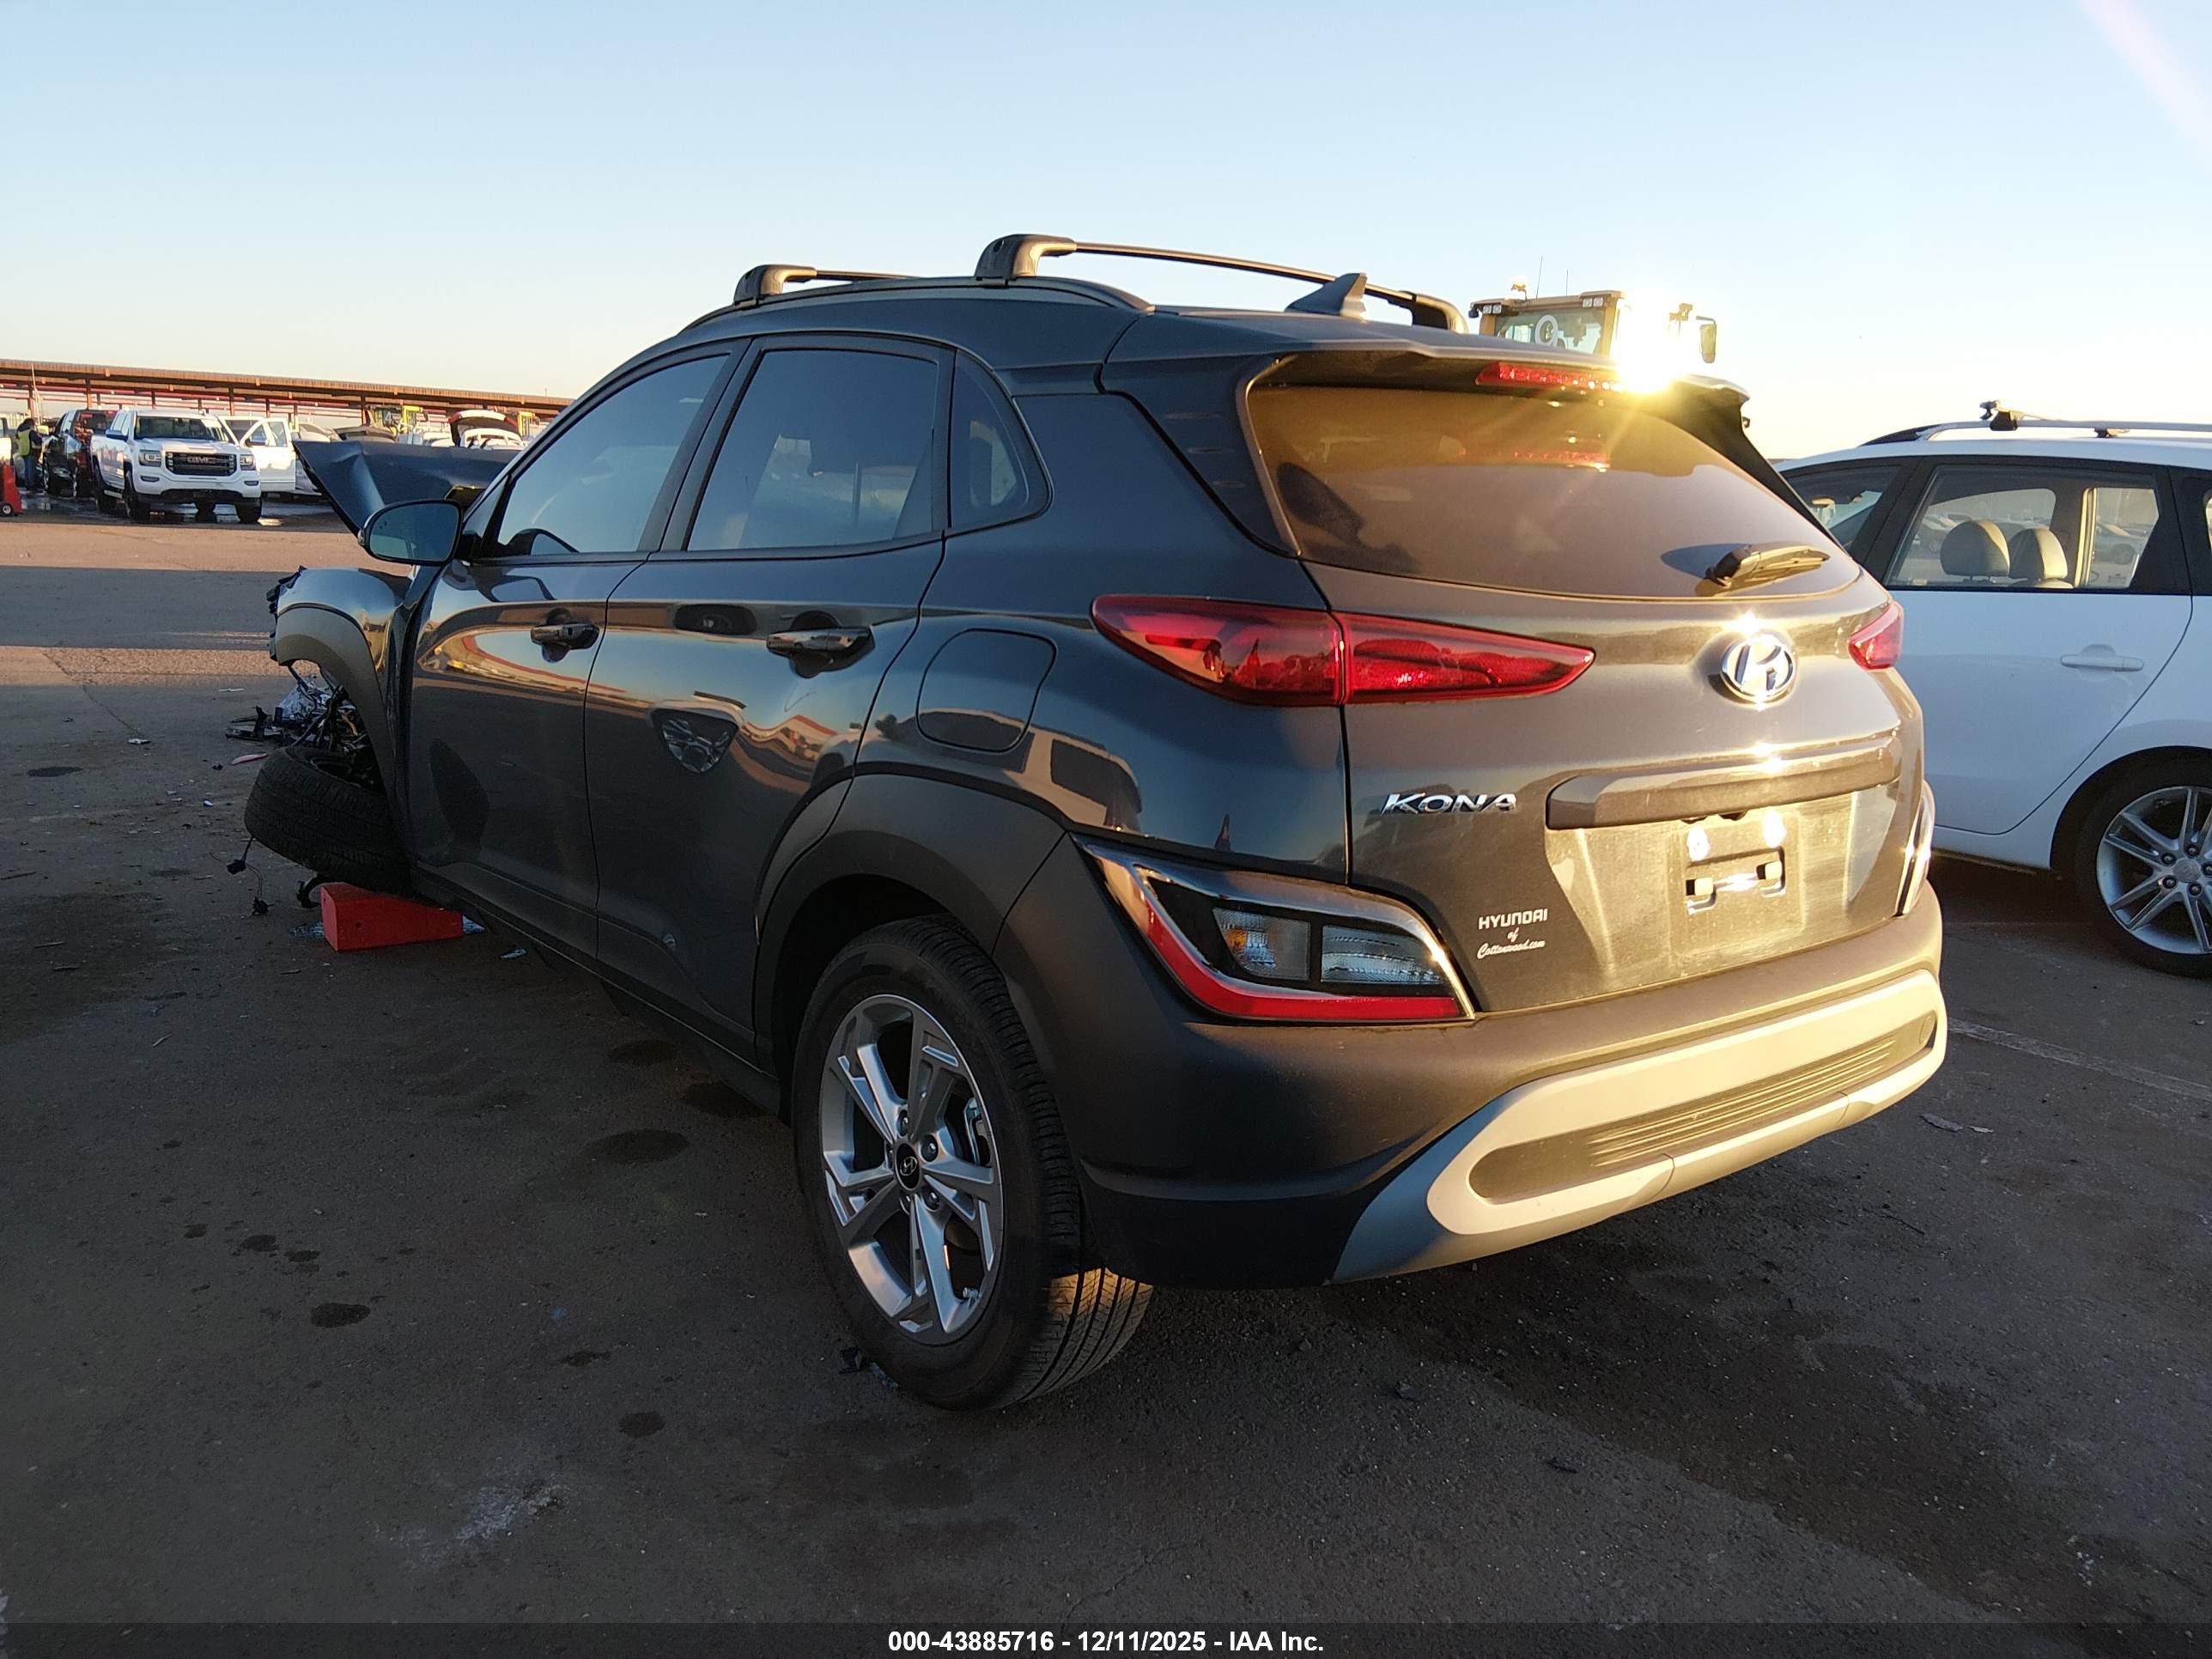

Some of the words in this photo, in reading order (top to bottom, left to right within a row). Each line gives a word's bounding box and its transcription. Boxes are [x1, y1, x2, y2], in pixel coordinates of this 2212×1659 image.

[1381, 793, 1516, 814] KONA
[1478, 908, 1548, 930] HYUNDAI
[1507, 927, 1520, 943] of
